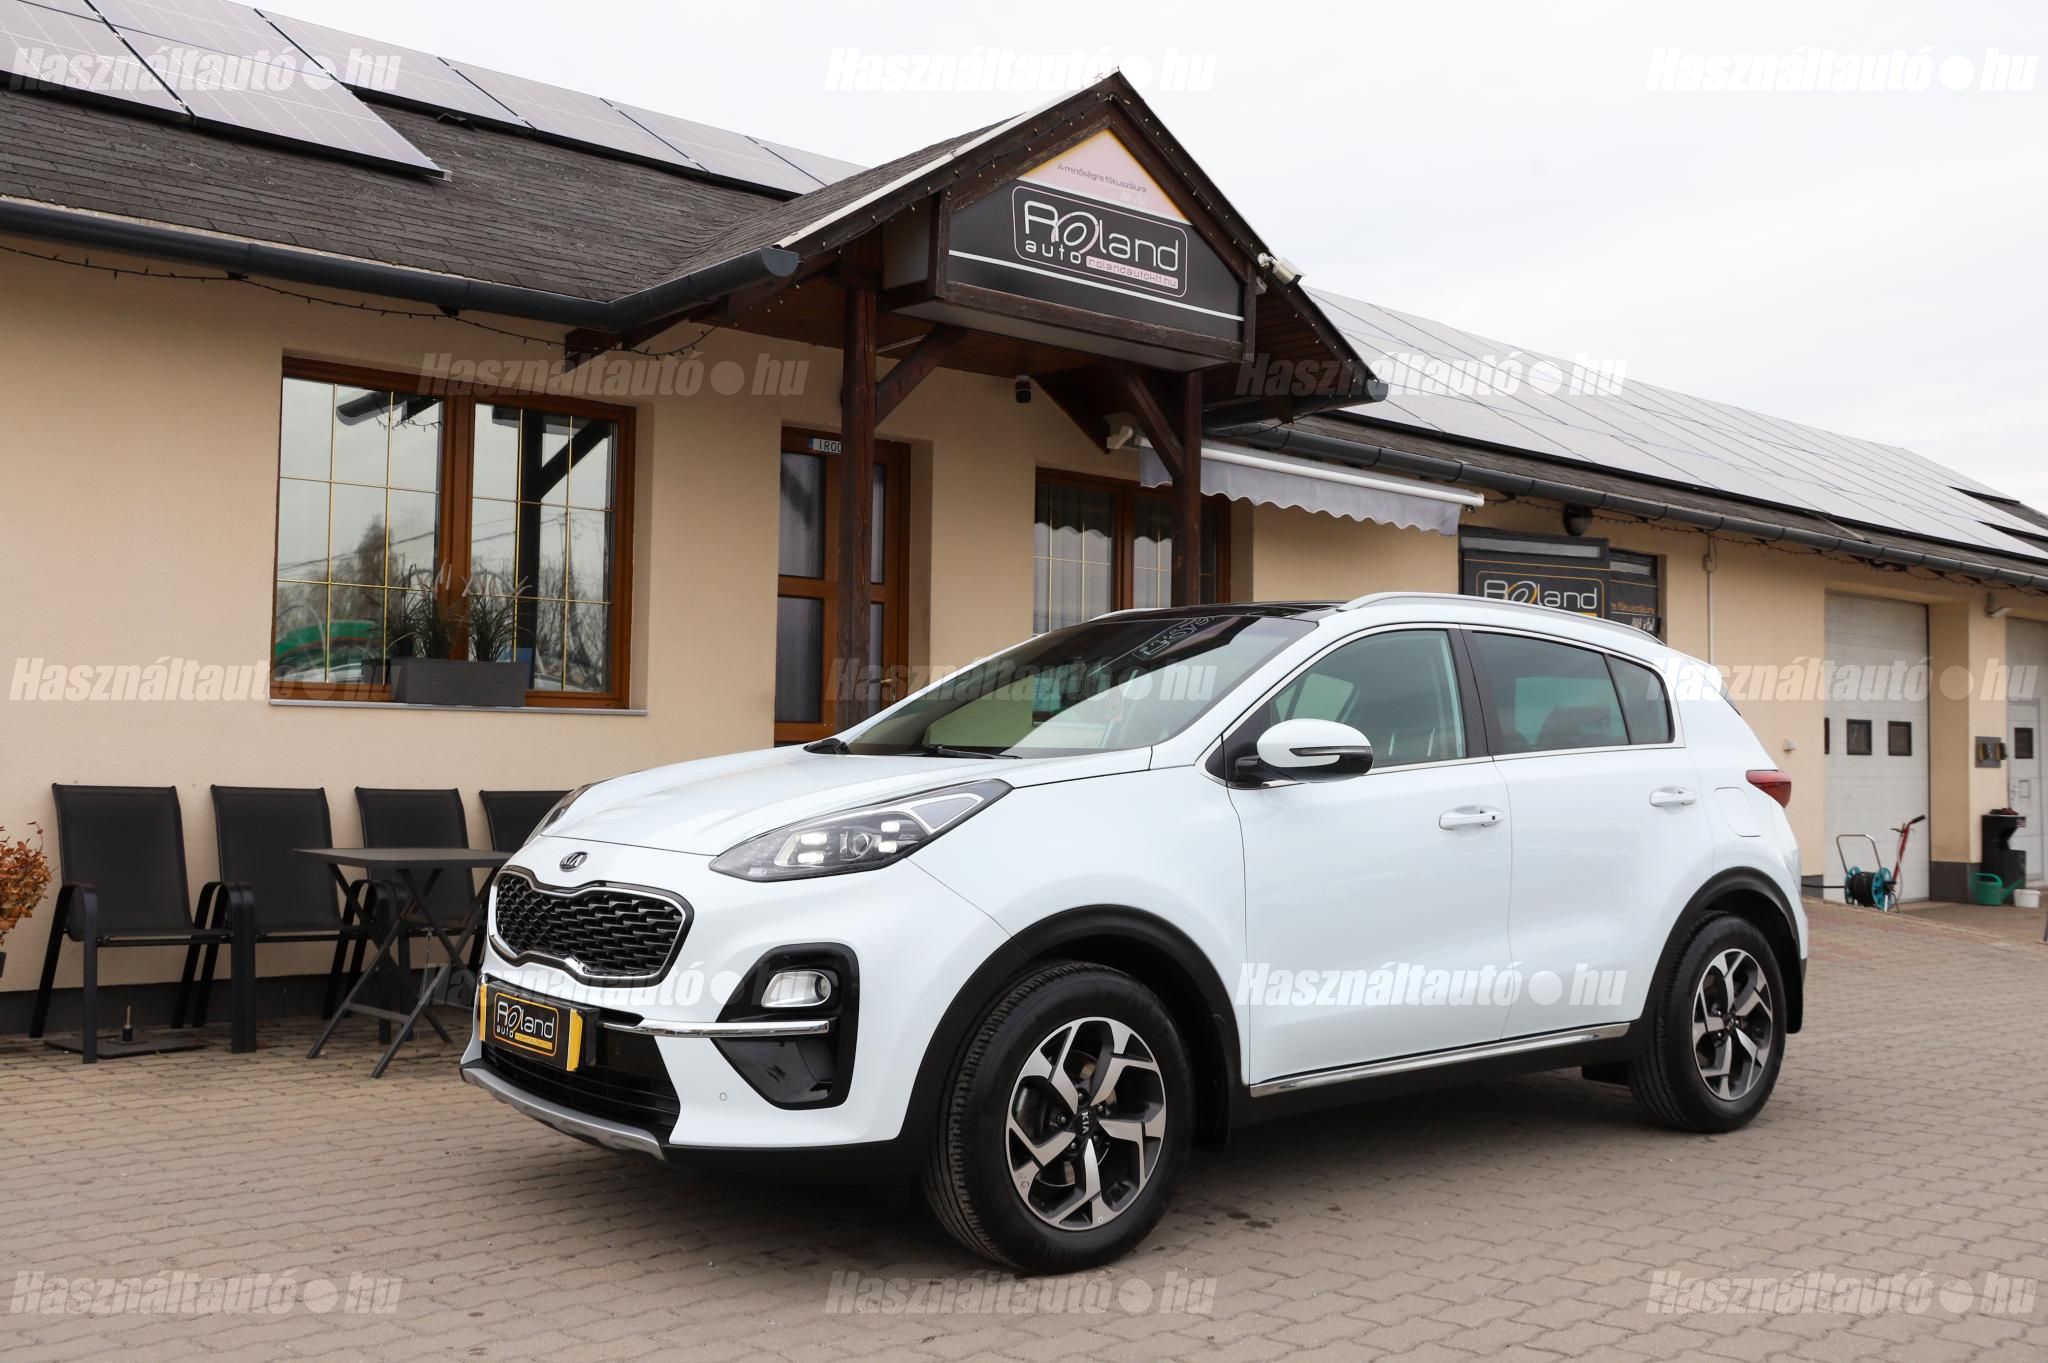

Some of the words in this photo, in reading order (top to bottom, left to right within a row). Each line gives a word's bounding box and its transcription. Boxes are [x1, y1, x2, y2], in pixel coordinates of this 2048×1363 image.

[1025, 239, 1081, 264] auto
[496, 1024, 514, 1039] auto
[1081, 1111, 1090, 1134] KIA
